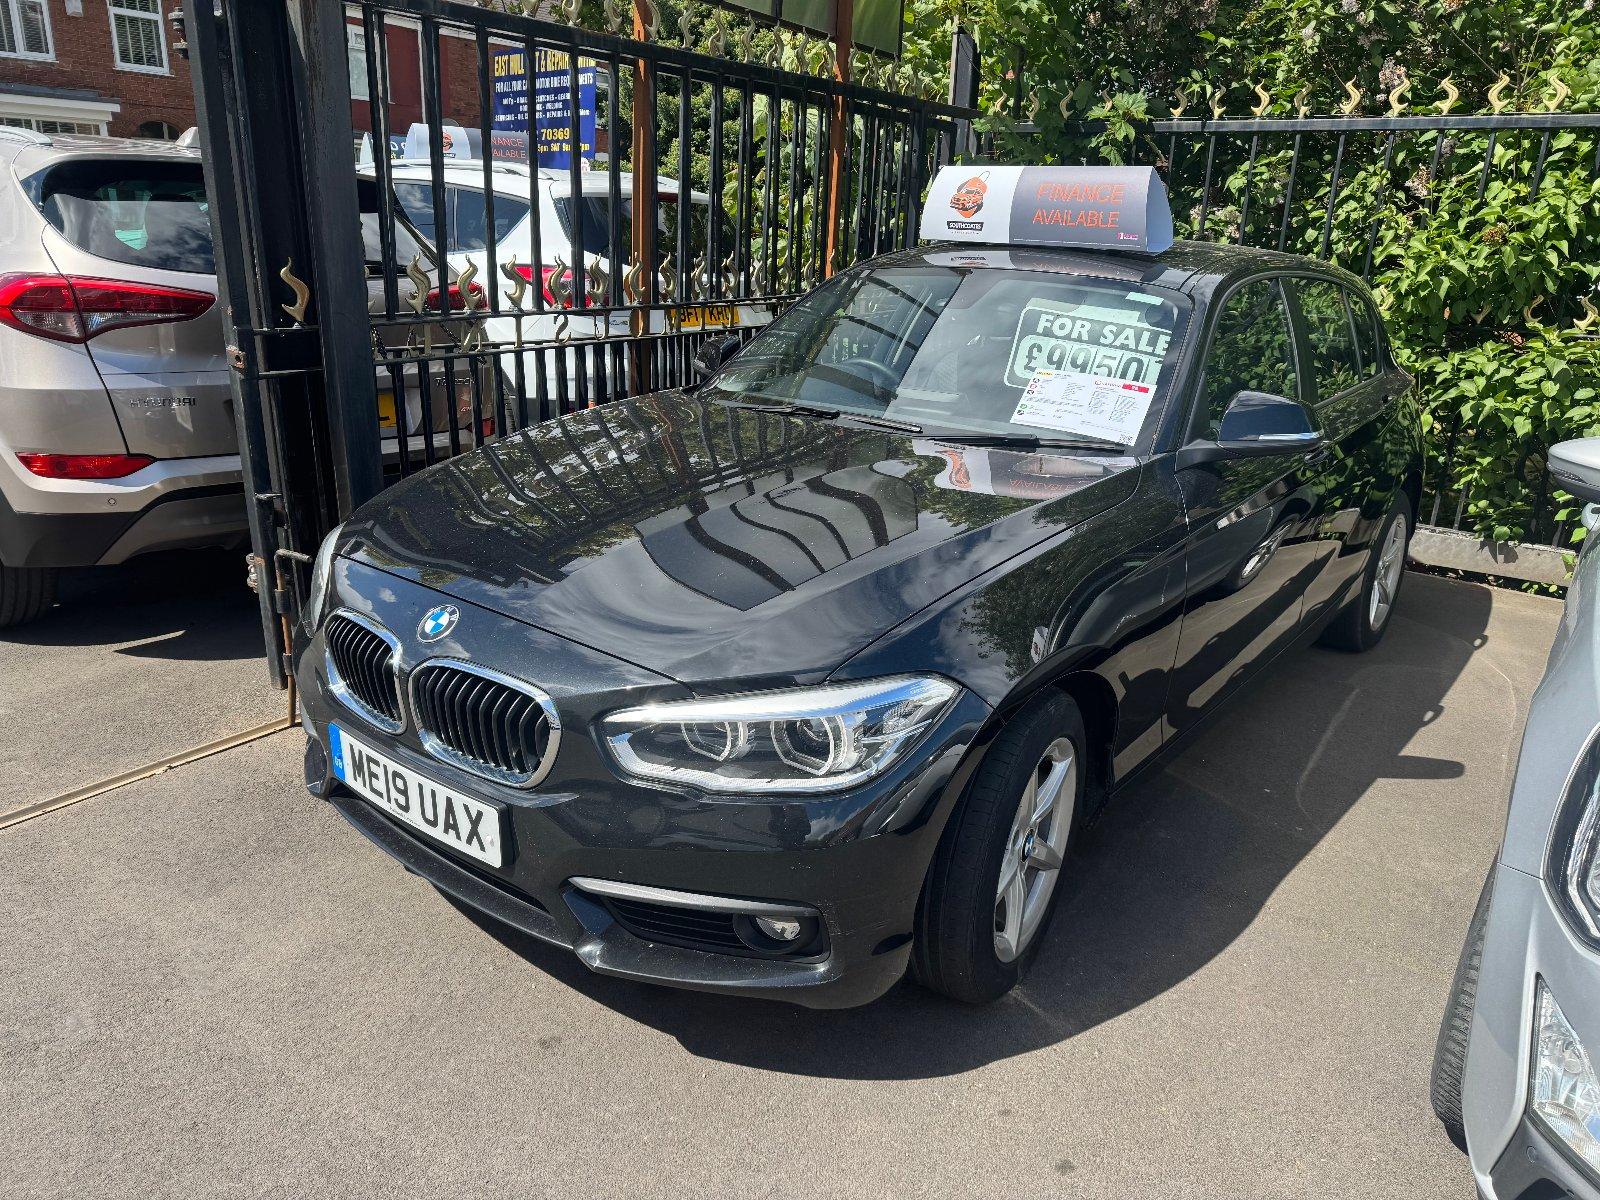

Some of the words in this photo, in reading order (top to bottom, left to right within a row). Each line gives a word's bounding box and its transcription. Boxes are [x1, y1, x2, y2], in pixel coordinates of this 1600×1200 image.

[491, 137, 524, 148] NANCE
[492, 148, 527, 159] AILABLE
[1036, 183, 1127, 205] FINANCE
[1031, 209, 1121, 229] AVAILABLE
[1035, 313, 1092, 341] FOR
[1099, 325, 1172, 355] SALE
[348, 742, 411, 813] ME19
[417, 782, 487, 853] UAX
